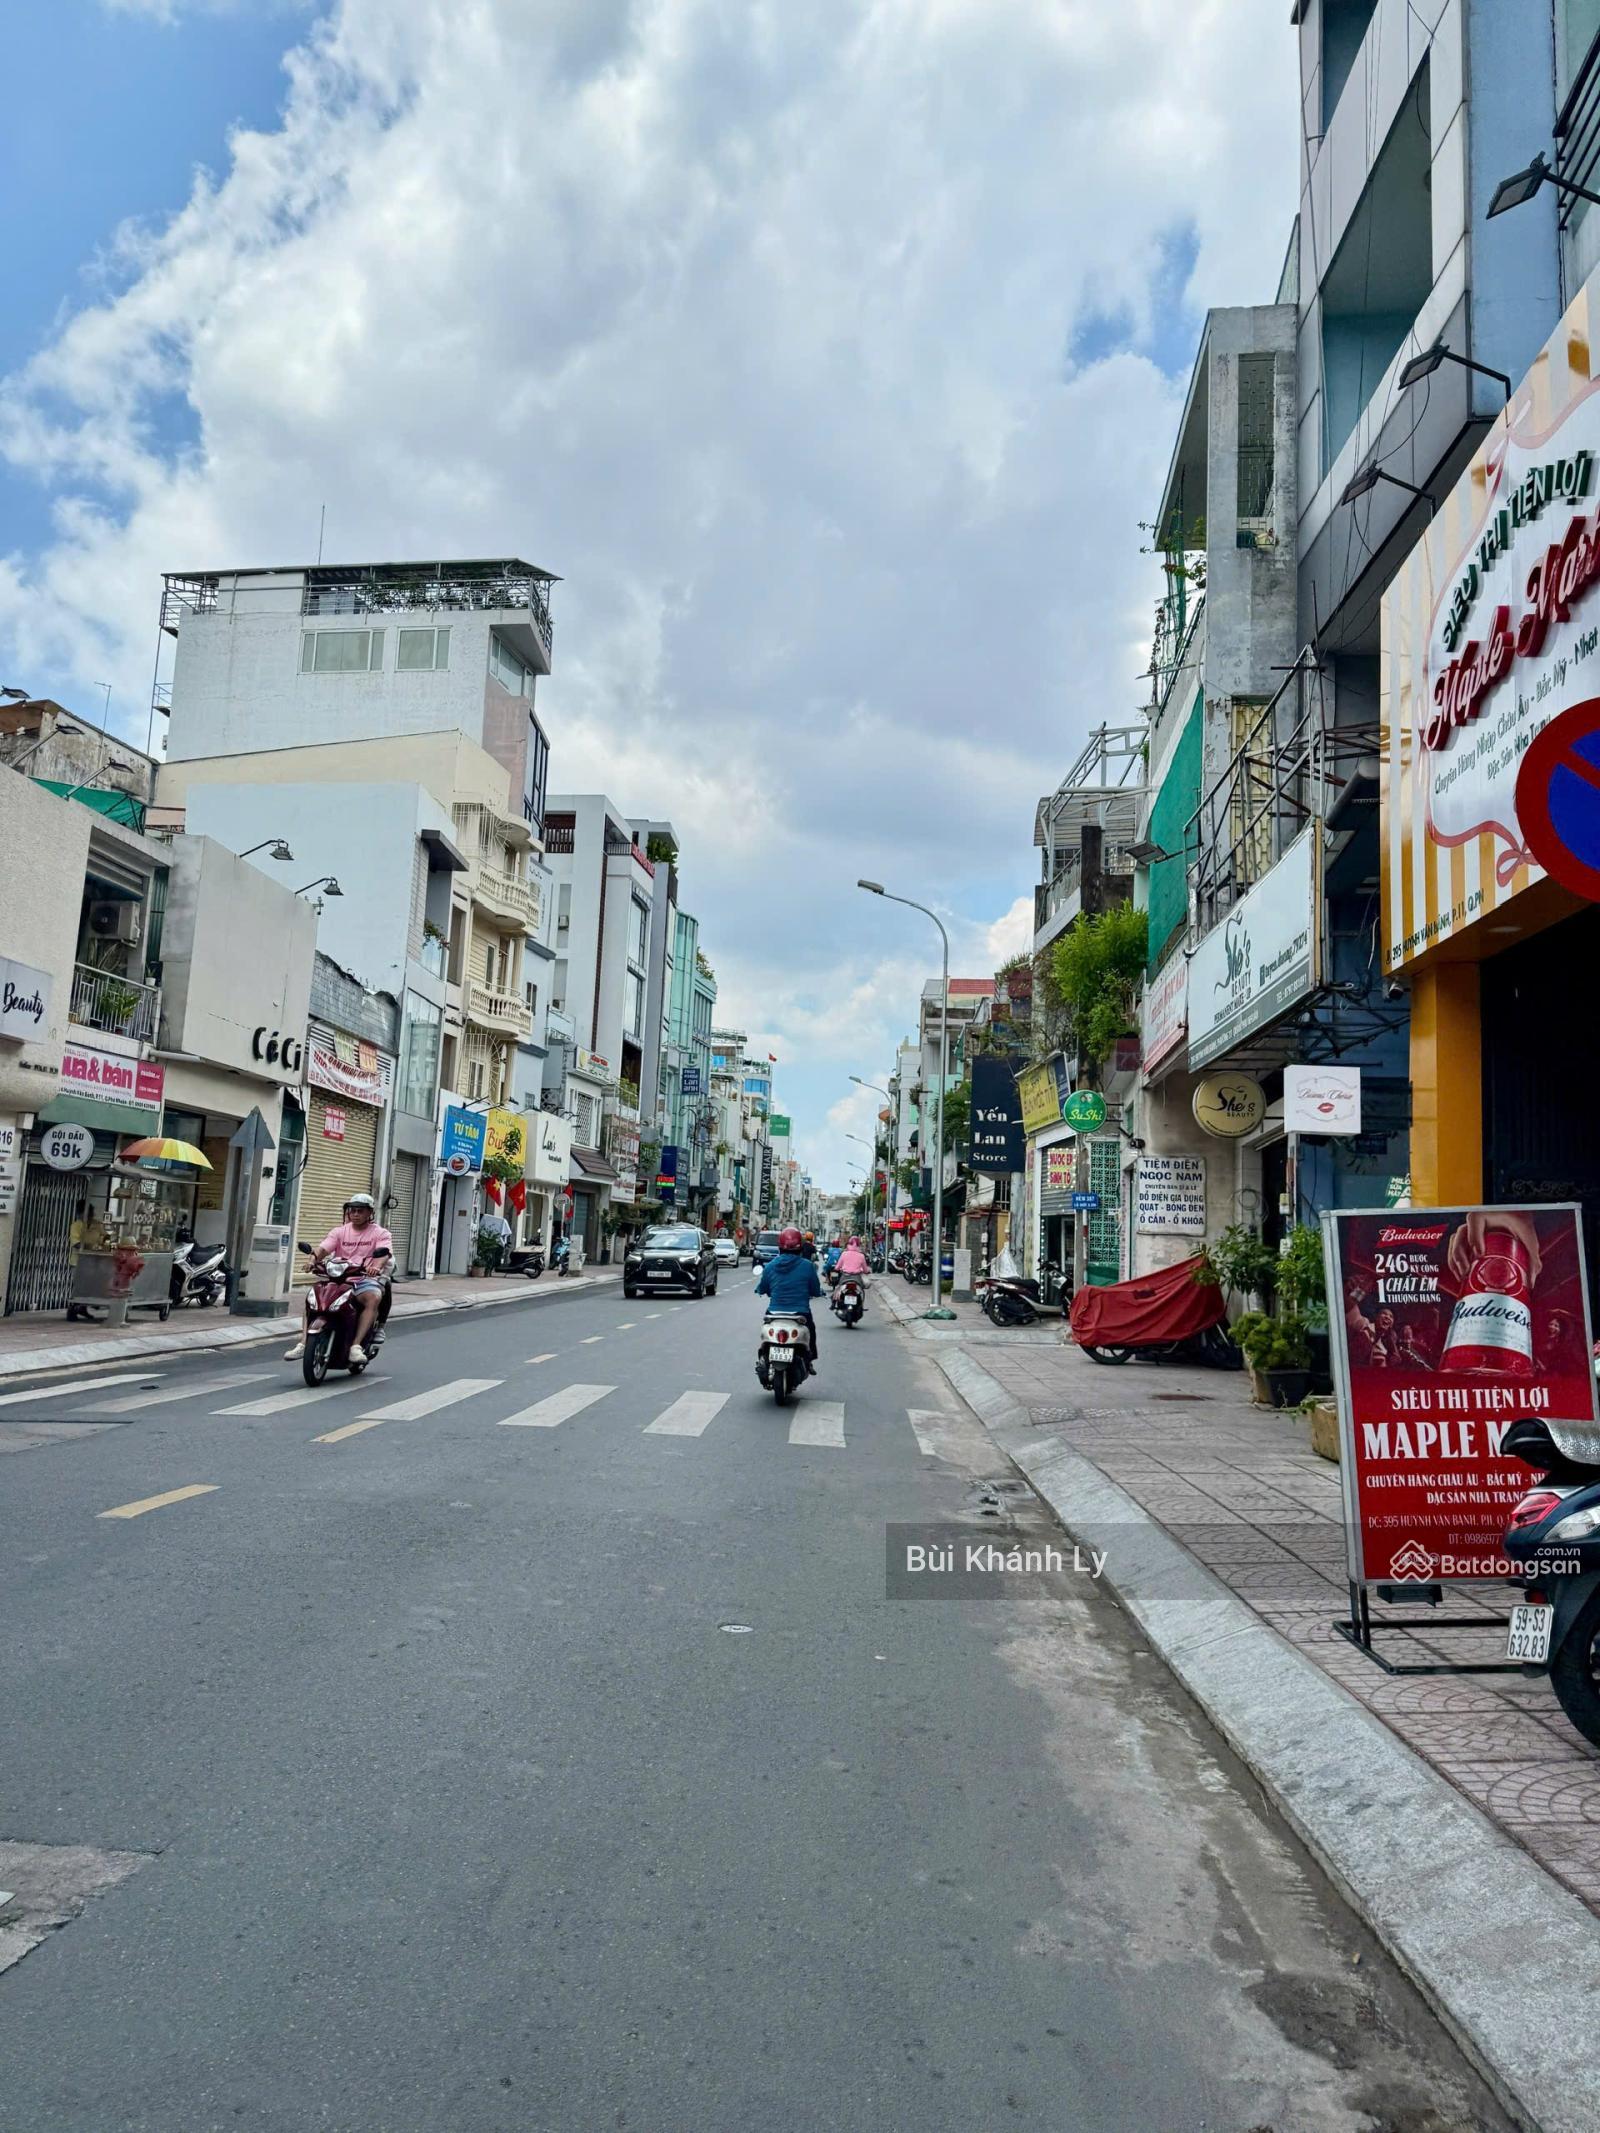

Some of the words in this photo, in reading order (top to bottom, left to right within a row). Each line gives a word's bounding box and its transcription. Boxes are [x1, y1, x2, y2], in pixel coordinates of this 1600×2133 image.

[1443, 564, 1478, 652] SIÊU
[1507, 467, 1556, 529] TIỆN
[1423, 606, 1515, 751] Maple
[3, 982, 45, 1024] Beauty
[976, 1106, 1008, 1122] Yến
[974, 1132, 1006, 1145] Lan
[51, 1142, 82, 1158] 69k
[972, 1152, 1007, 1162] Store
[1144, 1158, 1170, 1170] TIỆM
[1173, 1158, 1199, 1171] ĐIỆN
[1139, 1171, 1172, 1182] NGỌC
[1176, 1172, 1203, 1182] NAM
[1170, 1194, 1182, 1202] GIA
[1379, 1228, 1443, 1242] Budweiser
[1374, 1253, 1409, 1274] 246
[1421, 1263, 1439, 1273] CÔNG
[1376, 1279, 1386, 1303] 1
[1420, 1275, 1438, 1292] ÊM
[1420, 1293, 1441, 1304] HẠNG
[1391, 1387, 1431, 1410] SIÊU
[1435, 1389, 1469, 1412] THỊ
[1473, 1386, 1514, 1412] TIỆN
[1520, 1386, 1549, 1411] LỢI
[1362, 1421, 1479, 1460] MAPLE
[1485, 1420, 1516, 1457] M
[1366, 1472, 1405, 1488] CHUYÊN
[1407, 1472, 1436, 1487] HÀNG
[1438, 1471, 1463, 1487] CHÂU
[1466, 1471, 1479, 1486] ÂU
[1487, 1469, 1506, 1486] BẮC
[1507, 1470, 1522, 1486] MỸ
[1427, 1489, 1446, 1505] ĐẶC
[1447, 1488, 1468, 1504] SẢN
[1469, 1491, 1491, 1503] NHA
[1383, 1515, 1399, 1528] 395
[1509, 1633, 1546, 1658] 632.83
